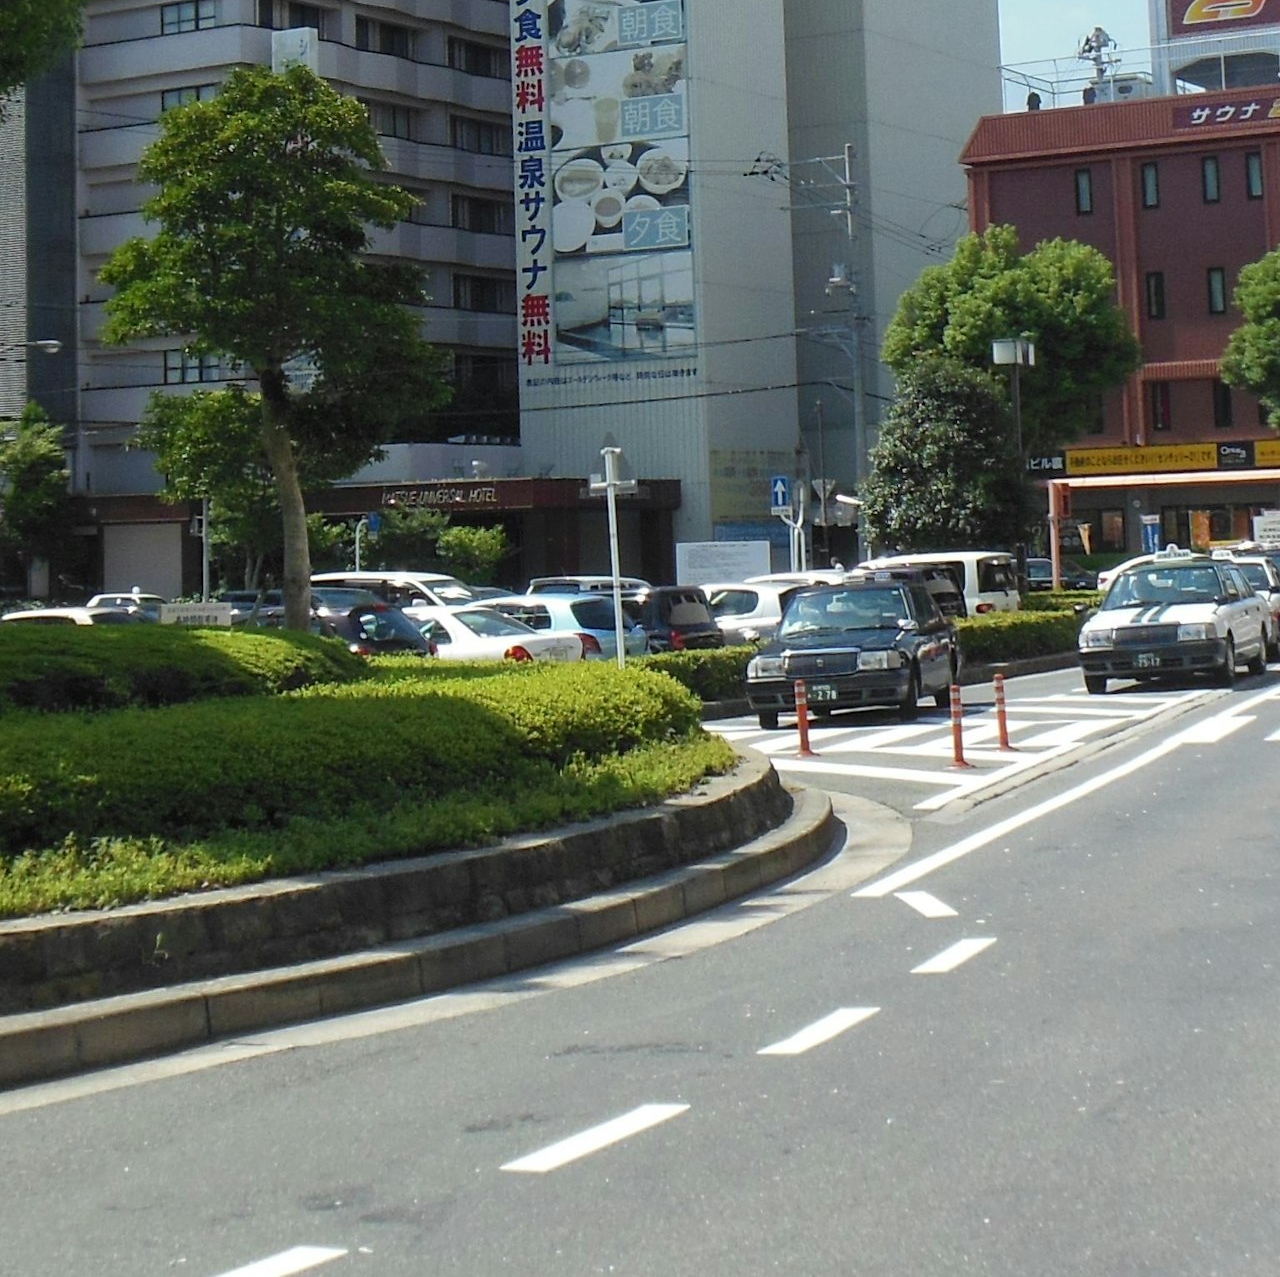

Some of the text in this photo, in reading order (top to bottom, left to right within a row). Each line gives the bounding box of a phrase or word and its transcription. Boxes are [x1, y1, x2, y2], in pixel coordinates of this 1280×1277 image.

[622, 3, 678, 40] 朝食
[623, 97, 681, 135] 朝食
[1190, 102, 1261, 125] サウナ
[516, 119, 552, 366] 温泉サウナ無料
[628, 209, 683, 247] 夕食
[418, 488, 466, 505] UNIVERSAL
[467, 486, 498, 504] HOTEL
